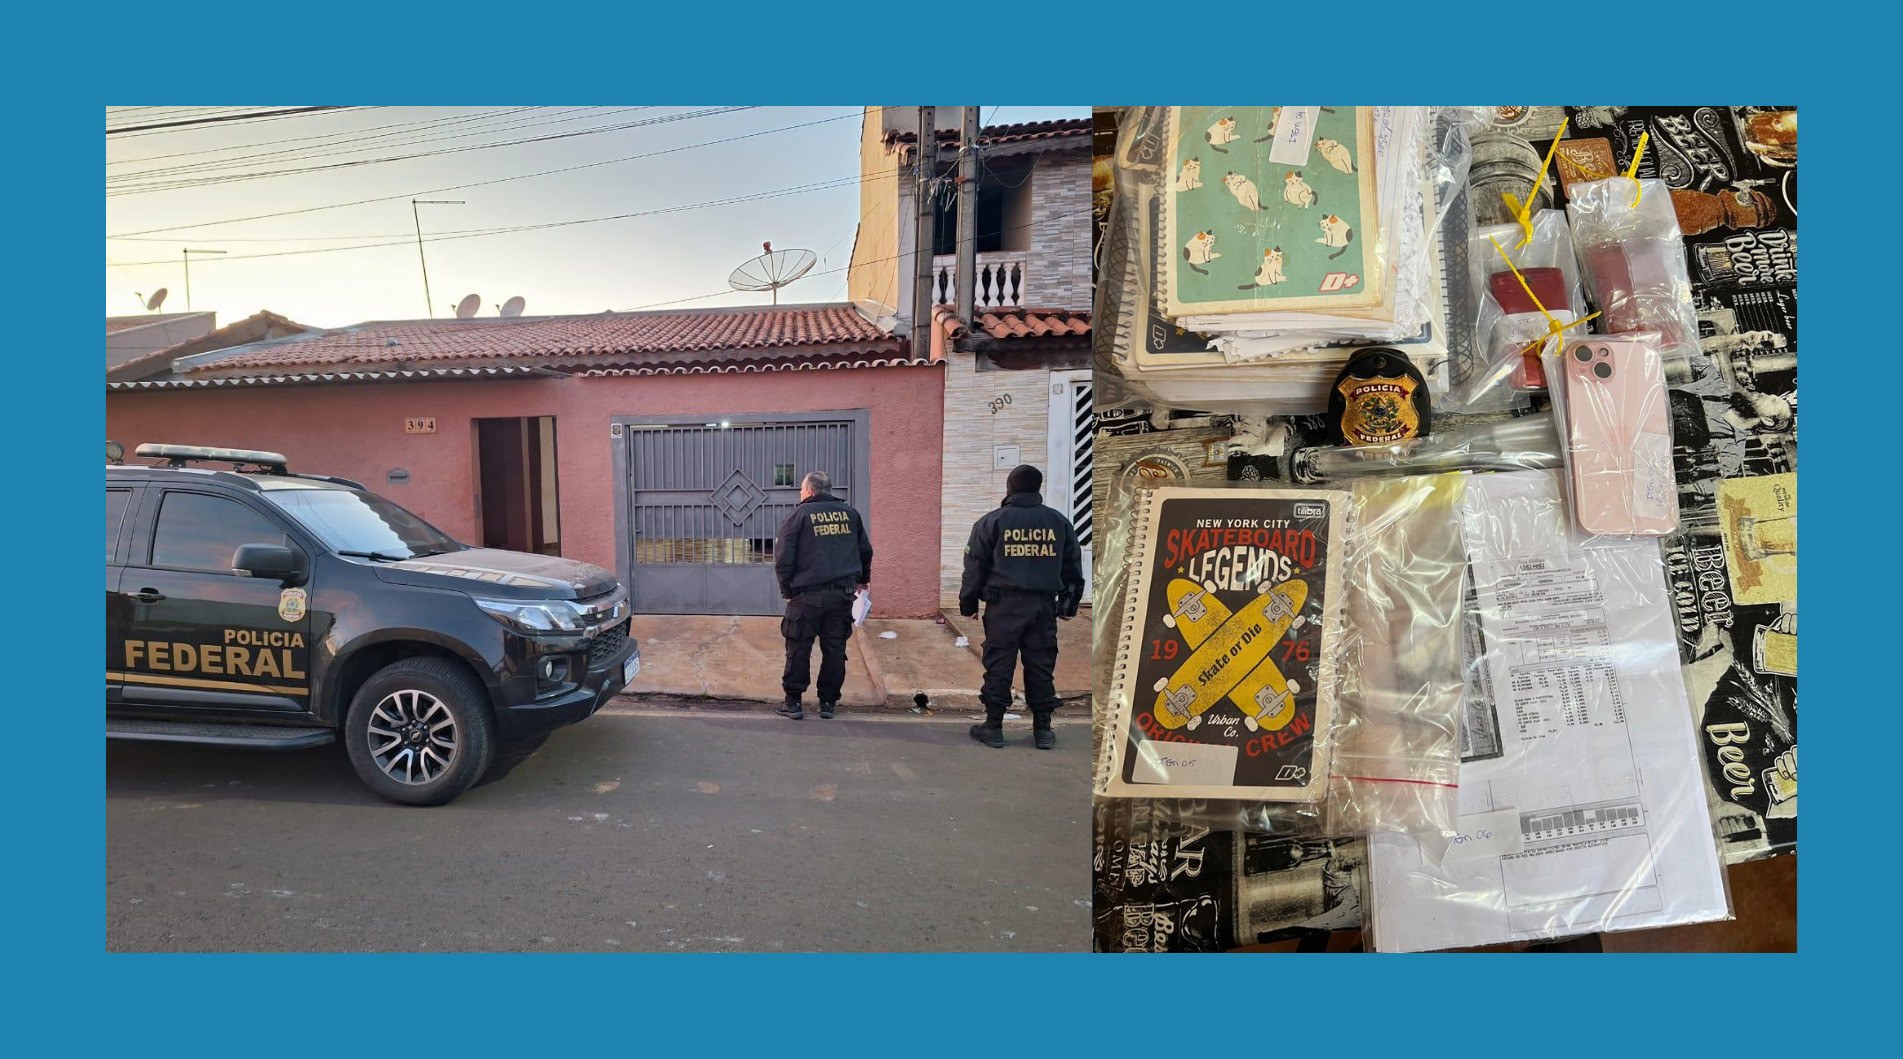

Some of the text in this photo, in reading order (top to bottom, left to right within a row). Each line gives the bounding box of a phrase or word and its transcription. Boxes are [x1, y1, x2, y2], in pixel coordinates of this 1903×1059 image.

[1656, 113, 1728, 192] BEER
[1725, 232, 1759, 286] Beer
[1750, 244, 1774, 283] more
[1757, 229, 1798, 283] Drink
[988, 393, 1012, 415] 390
[408, 420, 434, 430] 394
[1360, 433, 1402, 442] FEDERAL
[1773, 483, 1785, 512] Quality
[813, 523, 851, 537] FEDERAL
[1196, 519, 1290, 528] NEW YORK CITY
[1004, 544, 1057, 557] FEDERAL
[1163, 528, 1316, 568] SKATEBOARD
[1188, 545, 1292, 591] LEGENDS
[1691, 543, 1734, 629] Beer
[1665, 545, 1700, 633] ICE COLD
[124, 639, 306, 680] FEDERAL
[1151, 639, 1179, 660] 19
[1198, 622, 1262, 687] Skate or Die
[1282, 640, 1311, 662] 76
[1207, 713, 1240, 726] Urban
[1223, 726, 1239, 738] Co.
[1245, 711, 1311, 757] CREW
[1706, 720, 1756, 801] Beer
